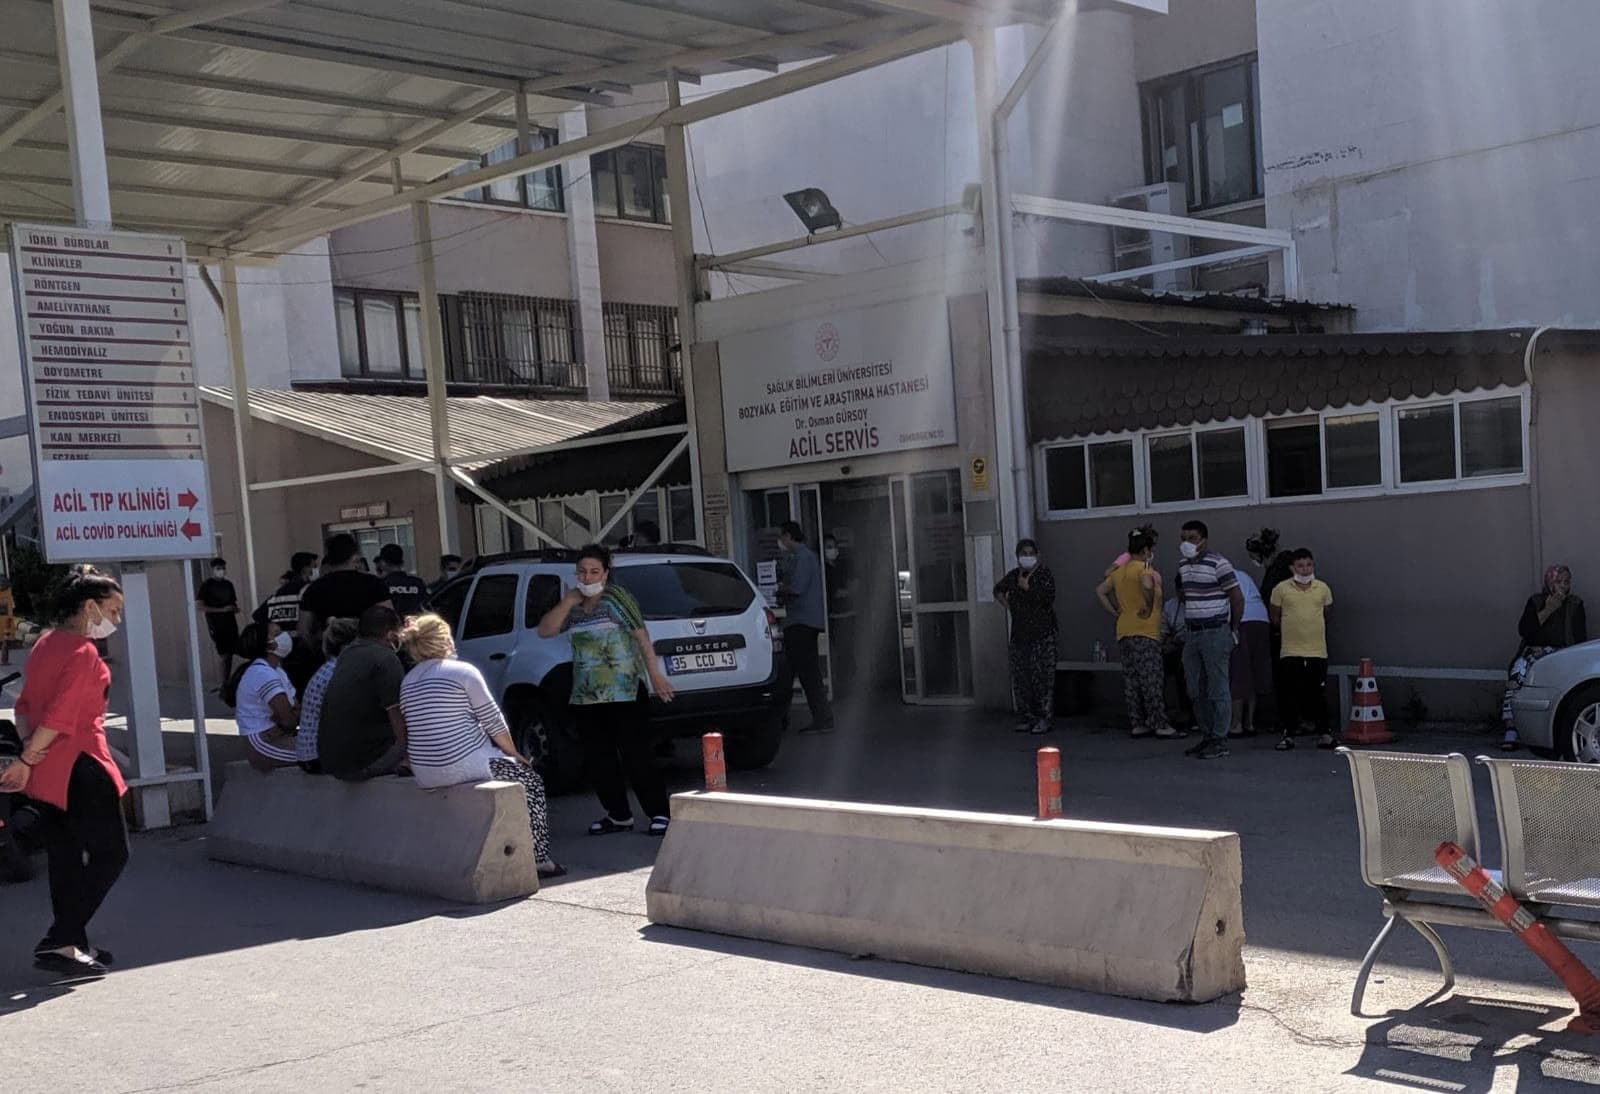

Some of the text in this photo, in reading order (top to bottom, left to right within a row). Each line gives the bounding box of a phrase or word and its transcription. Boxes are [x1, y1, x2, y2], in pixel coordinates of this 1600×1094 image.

[29, 234, 57, 246] İDARİ
[31, 256, 82, 269] KLİNİKLER
[34, 278, 81, 291] RÖNTGEN
[37, 301, 111, 315] AMELİYATHANE
[40, 322, 114, 337] YOĞUN BAKIM
[766, 361, 893, 395] SAĞLIK BİLİMLERİ ÜNİVERSİTESİ
[77, 387, 110, 400] TEDAVİ
[738, 402, 776, 420] BOZYAKA
[780, 395, 809, 413] EĞİTİM
[810, 395, 822, 408] VE
[876, 375, 929, 398] HASTANESİ
[111, 409, 149, 422] ÜNİTESİ
[795, 408, 868, 430] Dr. Osman GÜRSOY
[50, 430, 121, 443] KAN MERKEZİ
[789, 422, 880, 458] ACİL SERVİS
[53, 487, 170, 513] ACİL TIP KLİNİĞİ
[56, 519, 177, 541] ACİL COVİD POLİKLİNİĞİ
[676, 642, 729, 653] DUSTER
[672, 656, 687, 670] 35
[721, 653, 734, 666] 43
